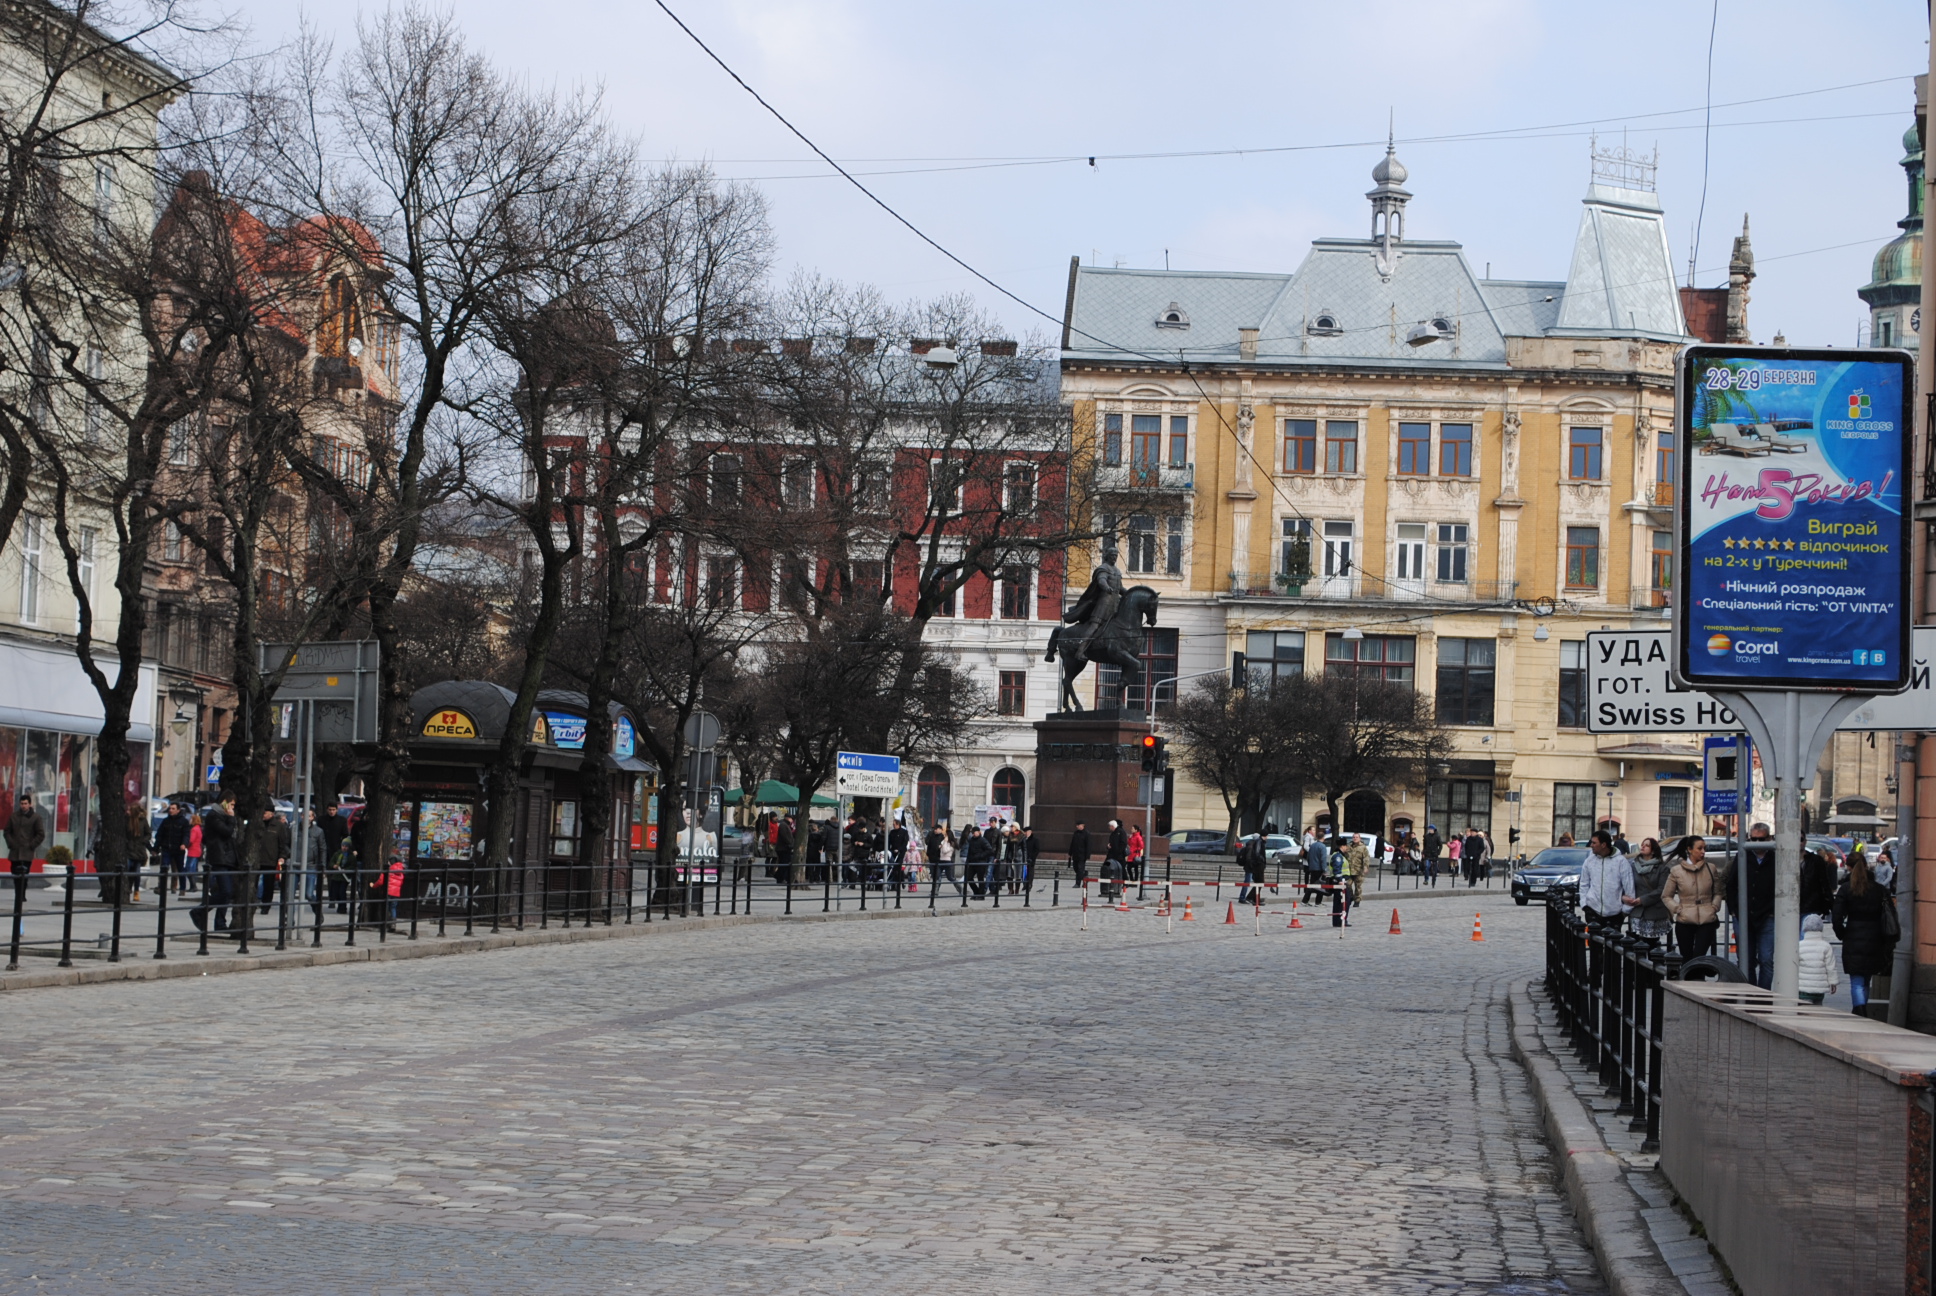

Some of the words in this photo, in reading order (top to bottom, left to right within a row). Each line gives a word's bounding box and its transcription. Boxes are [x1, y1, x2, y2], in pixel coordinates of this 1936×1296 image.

[1707, 368, 1761, 390] 28-29
[1763, 370, 1816, 385] БЕРЕЗНЯ
[1826, 420, 1853, 430] KING
[1856, 421, 1893, 431] CROSS
[1840, 431, 1879, 440] LEOPOLIS
[1755, 468, 1795, 520] 5
[1808, 519, 1878, 536] Виграй
[1799, 540, 1889, 554] відпочинок
[1704, 556, 1723, 567] на
[1765, 555, 1848, 572] Туреччині!
[1725, 580, 1777, 594] Нічний
[1780, 584, 1866, 598] розпродаж
[1702, 597, 1782, 611] Спеціальний
[1785, 600, 1819, 611] гість:
[1598, 639, 1666, 666] УДА
[1734, 640, 1779, 655] Coral
[1736, 654, 1761, 663] travel
[1787, 656, 1851, 665] www.kingcross.com.ua
[1598, 677, 1650, 694] гот.
[1598, 703, 1685, 727] Swiss
[1698, 702, 1737, 726] Ho
[426, 725, 473, 735] ПРЕСА
[554, 727, 579, 738] Orbit
[678, 840, 719, 858] mala
